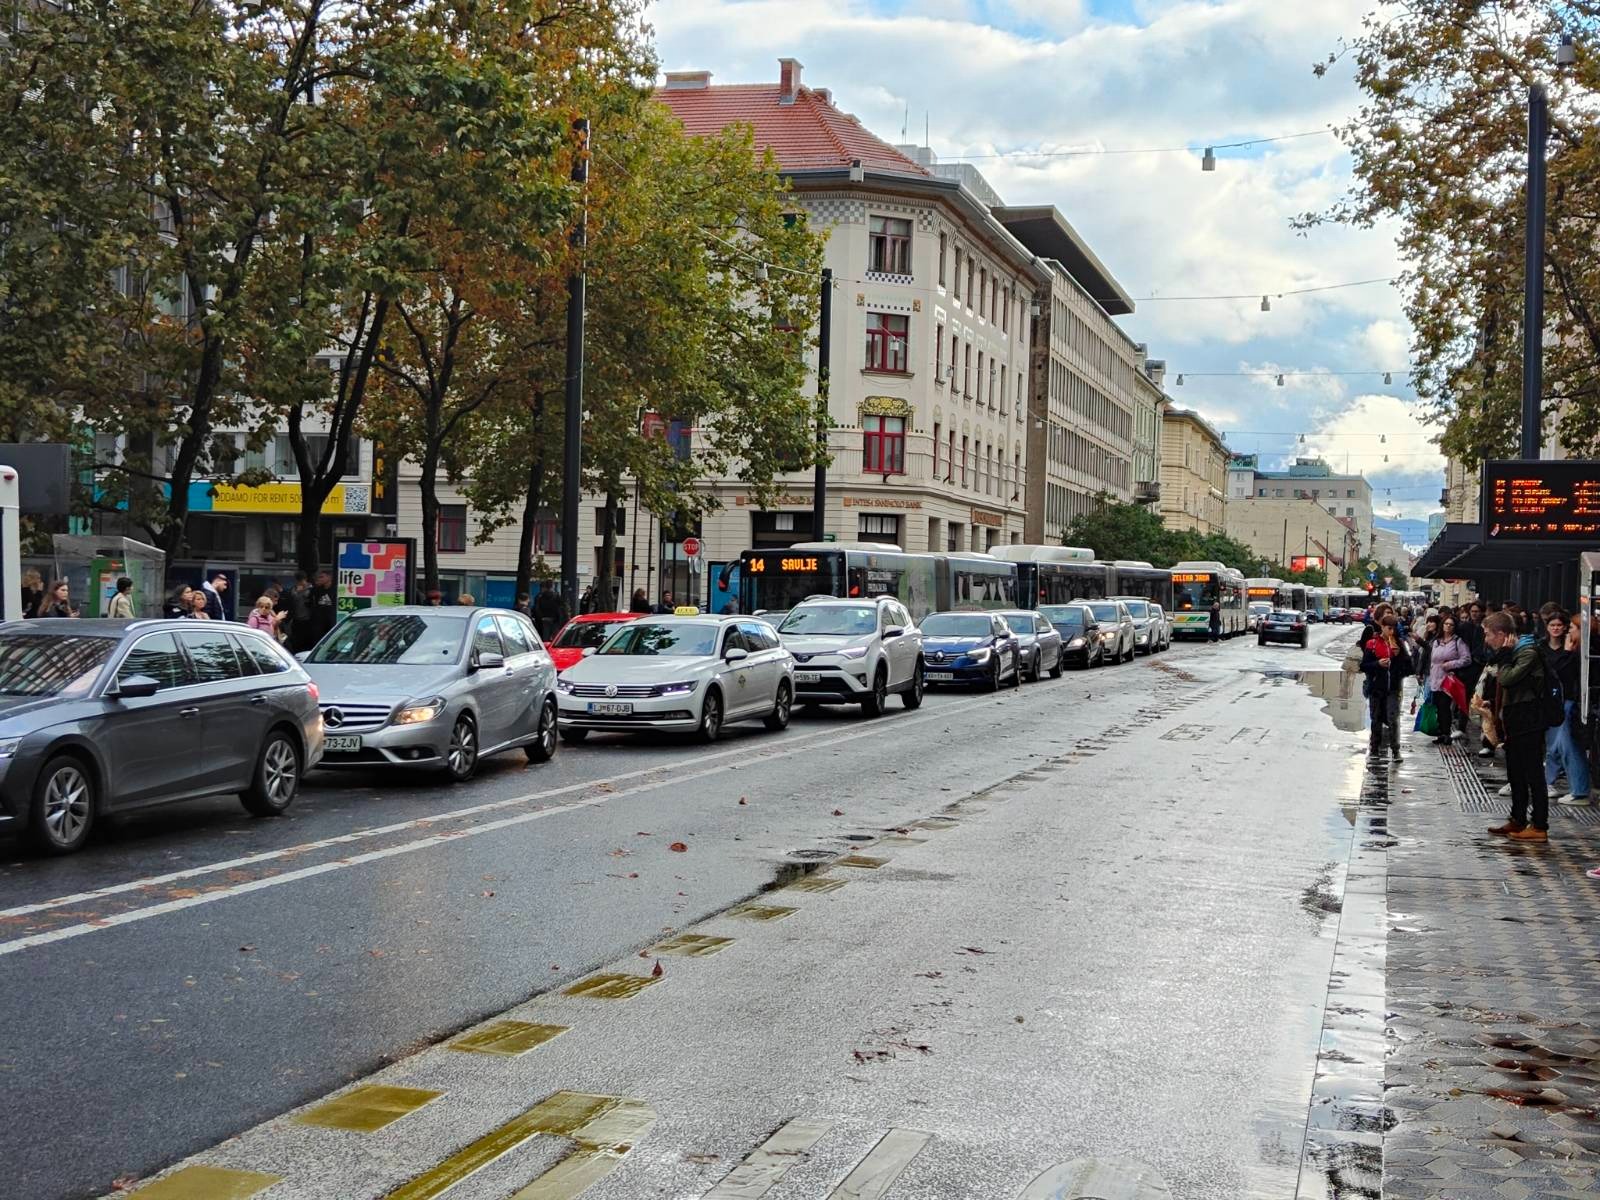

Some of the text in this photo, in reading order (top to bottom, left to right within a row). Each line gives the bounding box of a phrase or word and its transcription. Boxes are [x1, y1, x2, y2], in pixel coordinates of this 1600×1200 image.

[254, 492, 268, 504] FOR
[270, 492, 288, 504] RENT
[684, 543, 699, 551] STOP
[750, 558, 818, 572] 14 SAVLJE
[339, 570, 362, 585] life
